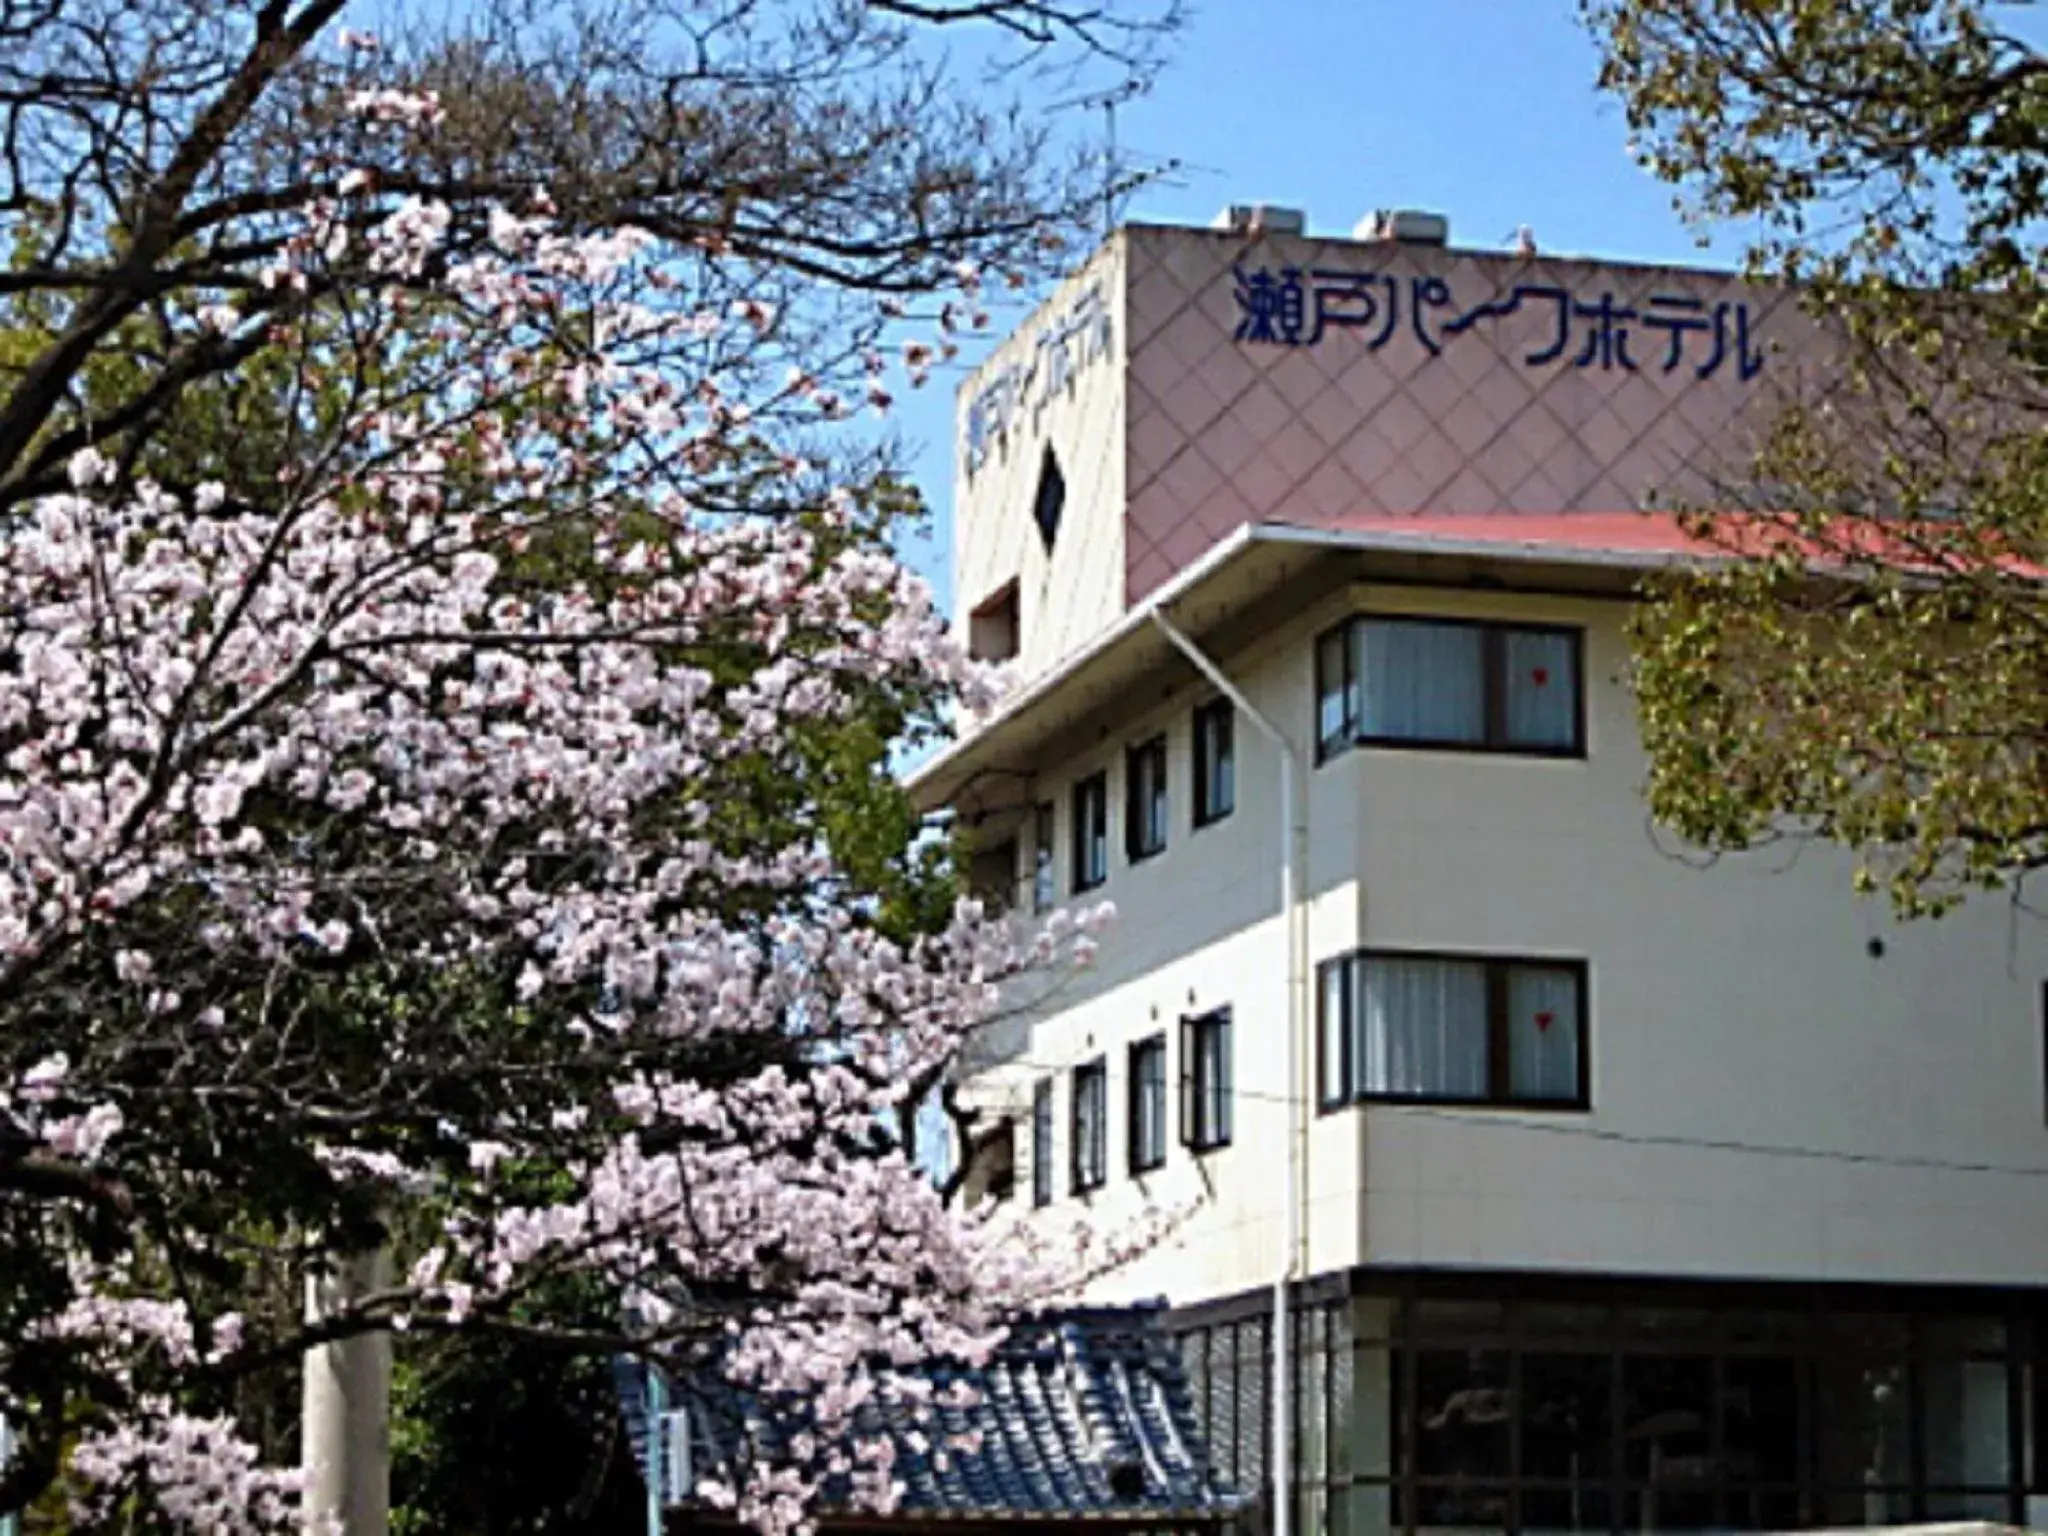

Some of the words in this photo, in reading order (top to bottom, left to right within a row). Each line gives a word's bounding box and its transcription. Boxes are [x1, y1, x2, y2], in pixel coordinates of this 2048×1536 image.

[1233, 264, 1763, 381] 瀬戸パークホテル
